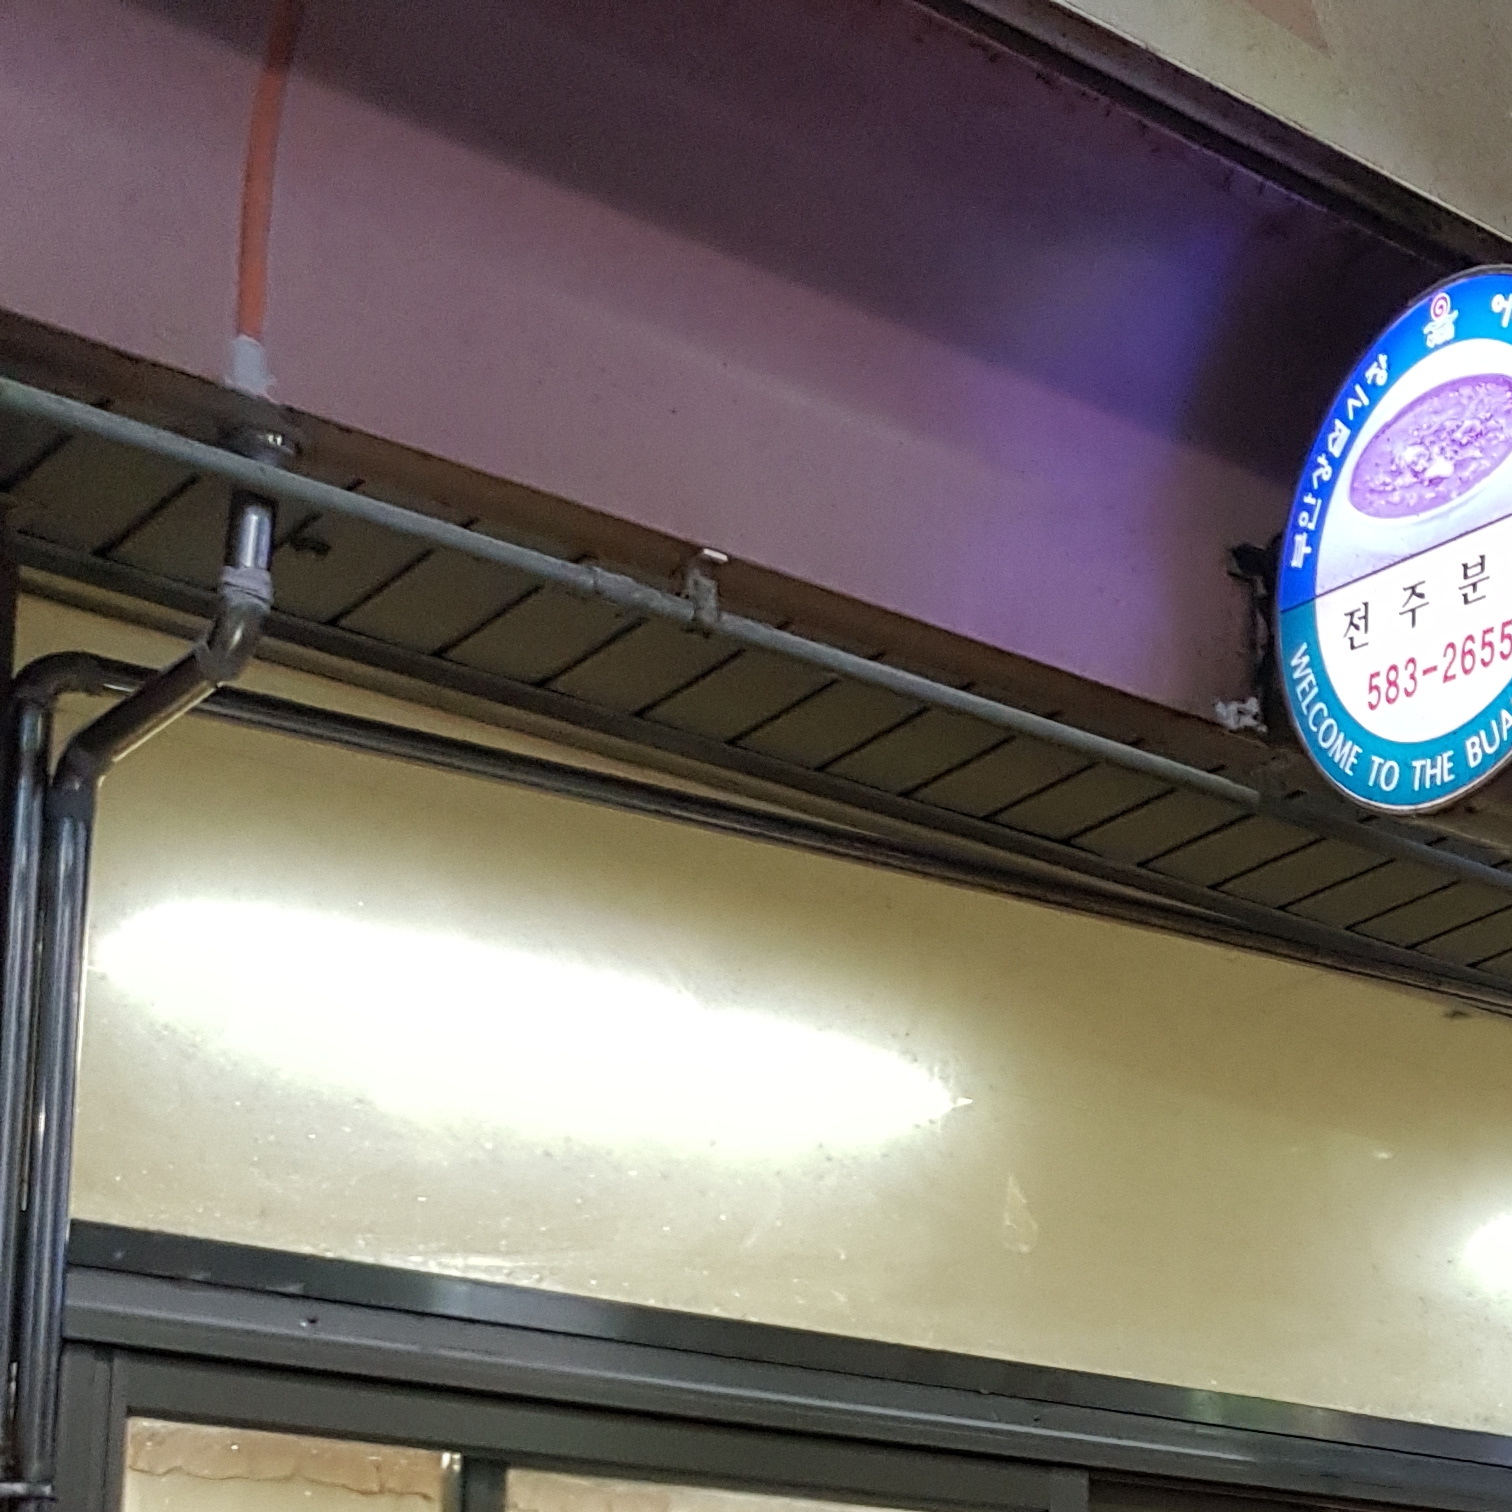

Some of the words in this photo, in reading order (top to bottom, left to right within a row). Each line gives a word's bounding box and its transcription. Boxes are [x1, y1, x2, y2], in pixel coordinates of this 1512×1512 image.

[1289, 643, 1360, 777] WELCOME
[1369, 755, 1399, 791] TO
[1412, 750, 1454, 791] THE
